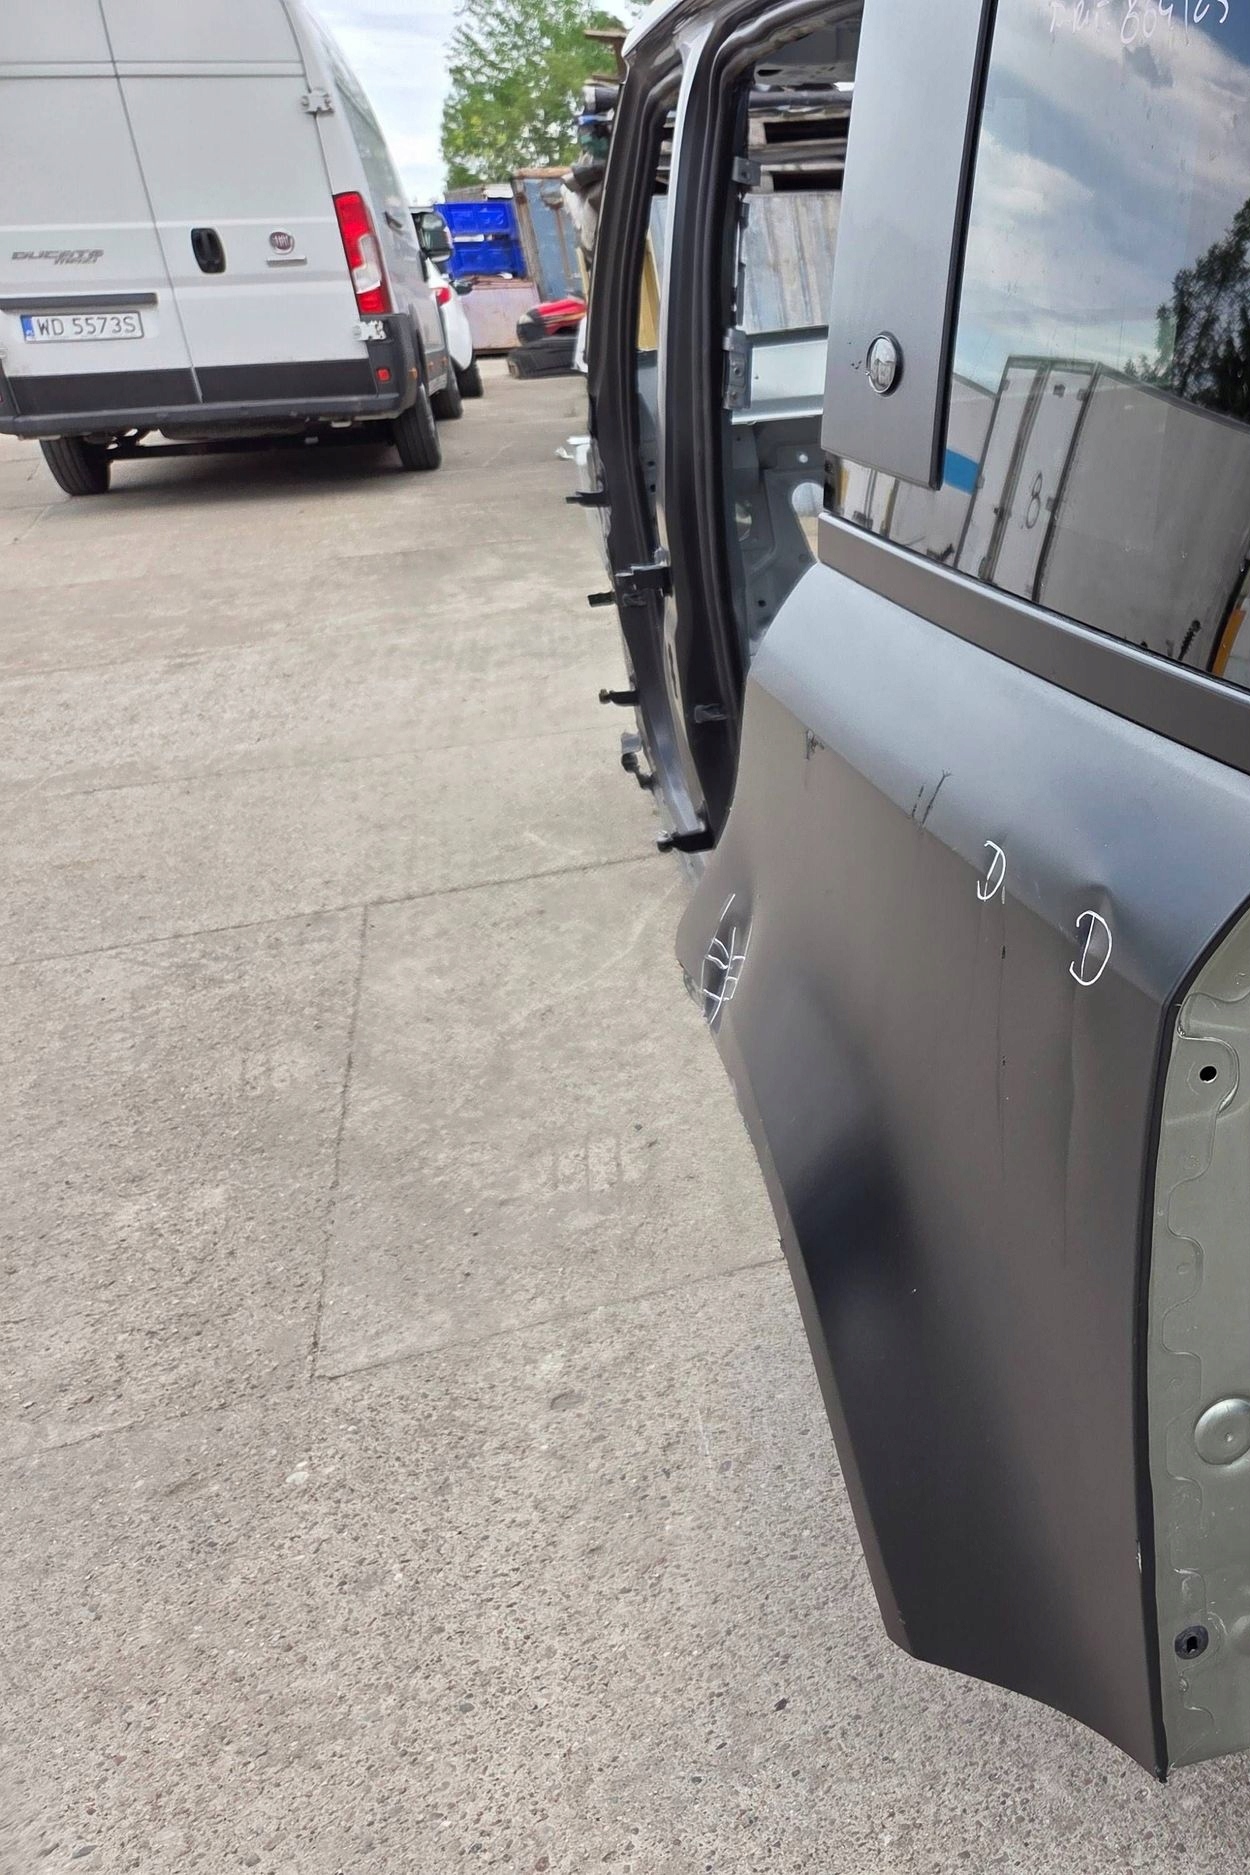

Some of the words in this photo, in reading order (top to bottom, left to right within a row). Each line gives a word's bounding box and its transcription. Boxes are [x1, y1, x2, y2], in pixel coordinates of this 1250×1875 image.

[36, 317, 65, 336] WD
[72, 315, 136, 335] 5573S
[1069, 910, 1112, 986] D
